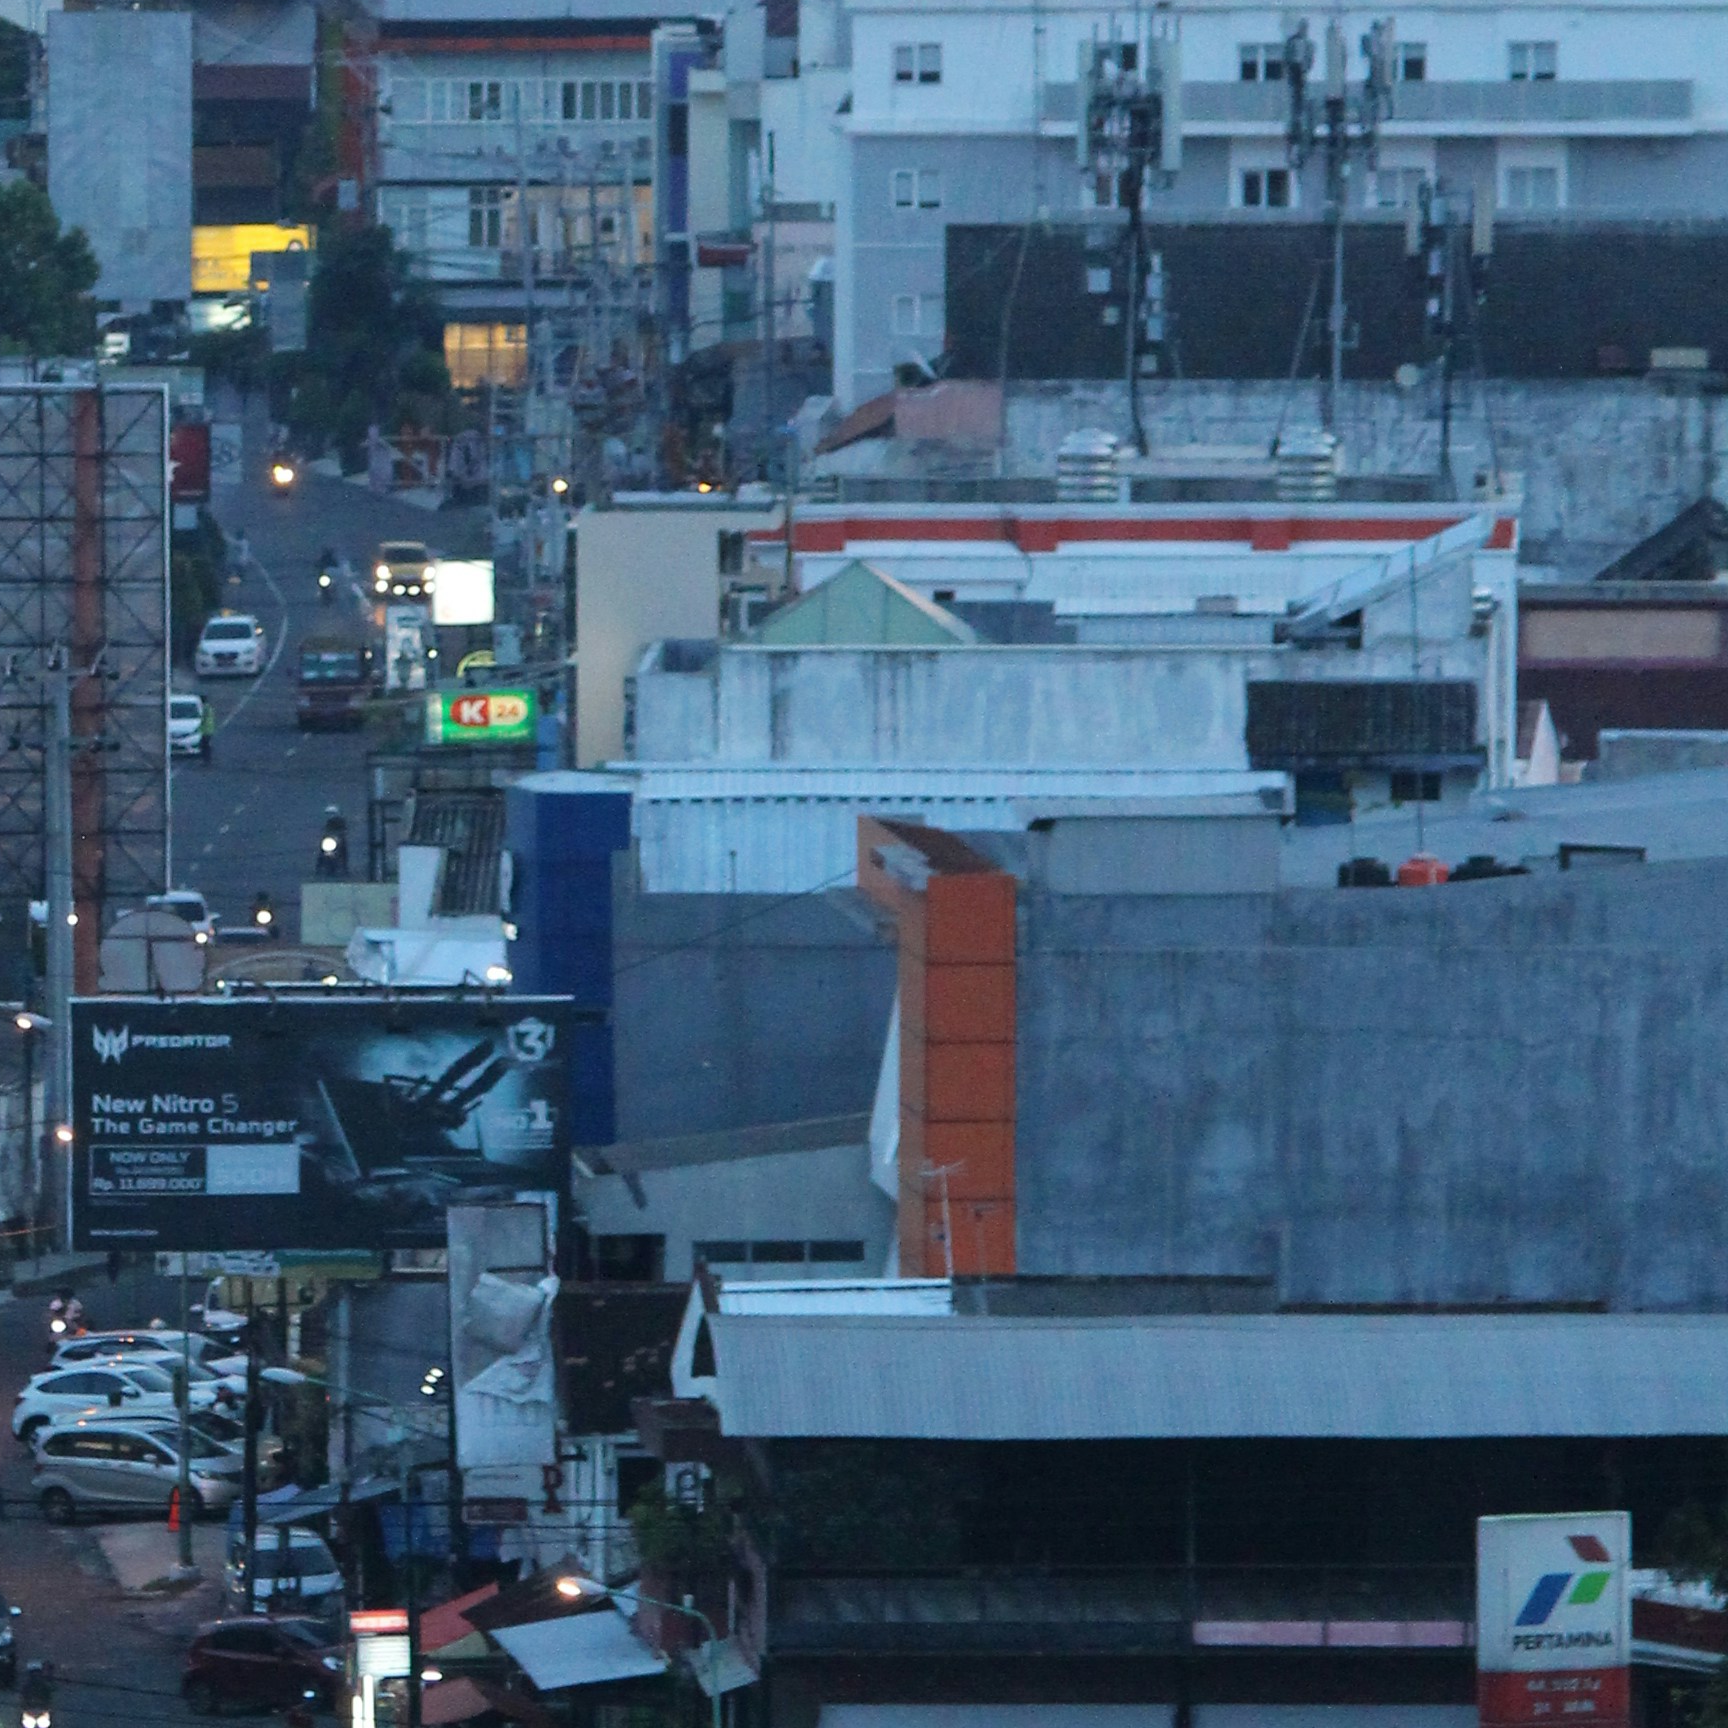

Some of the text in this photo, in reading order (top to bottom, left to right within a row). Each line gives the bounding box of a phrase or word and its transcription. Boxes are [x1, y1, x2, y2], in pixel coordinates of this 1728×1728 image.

[460, 699, 520, 725] K 24
[130, 1034, 233, 1048] PREDATOR
[91, 1093, 240, 1114] New Nitro 5
[90, 1116, 298, 1138] The Game Changer
[109, 1150, 191, 1164] NOW ONLY
[1512, 1631, 1613, 1651] PERTAMINA
